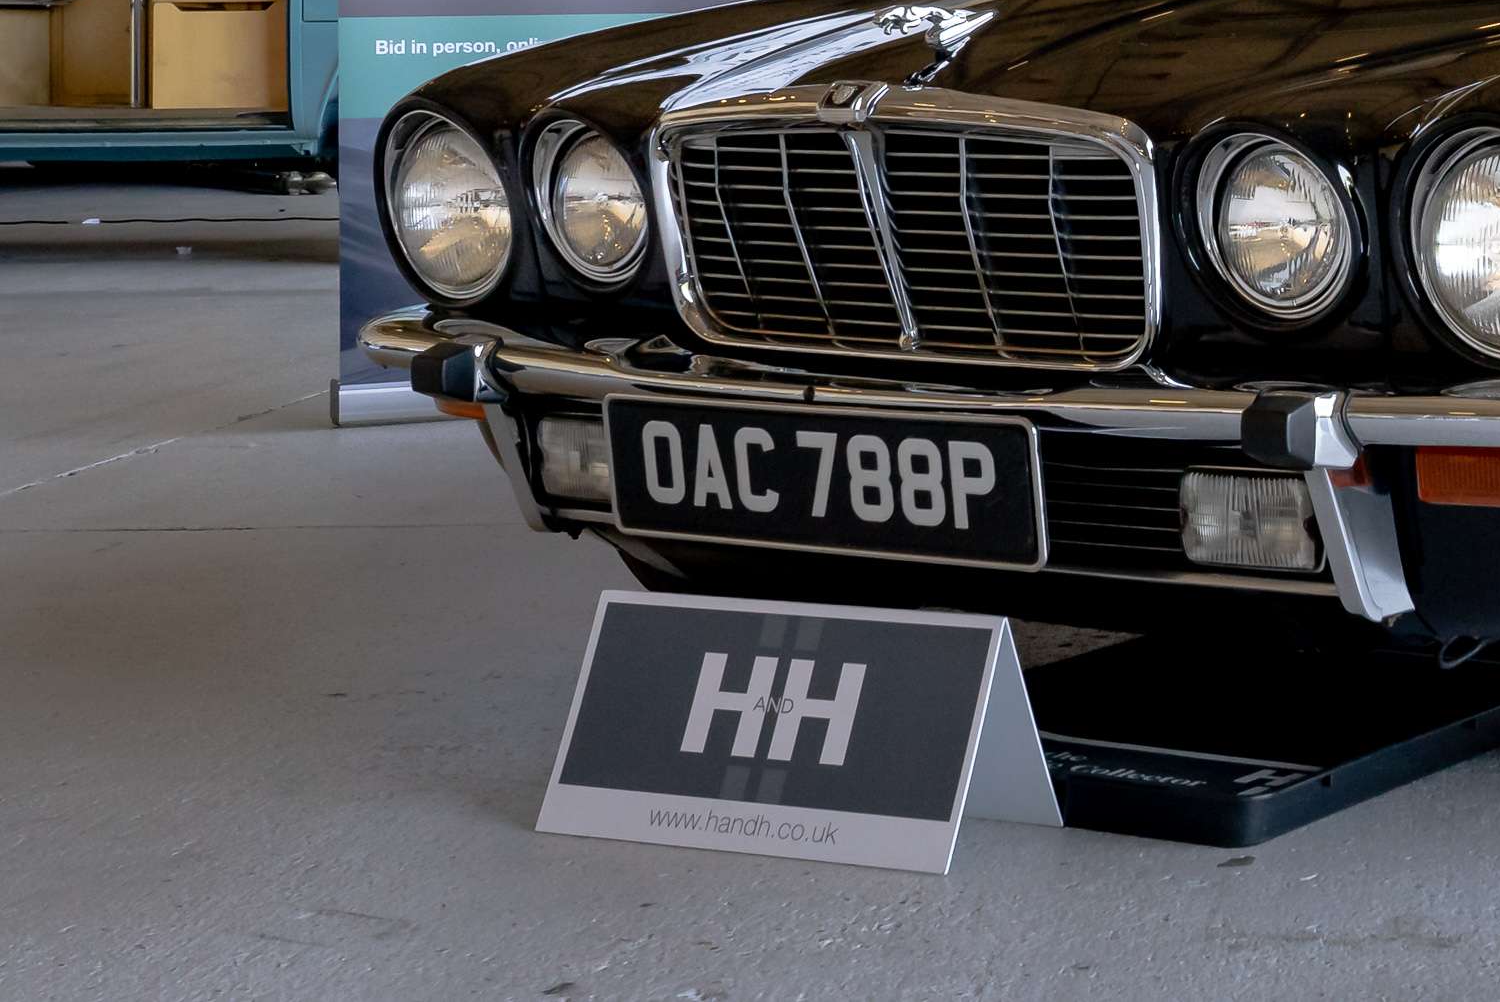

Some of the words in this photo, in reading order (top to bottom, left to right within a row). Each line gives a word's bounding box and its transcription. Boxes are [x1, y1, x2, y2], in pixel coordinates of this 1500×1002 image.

[376, 40, 405, 54] Bid
[412, 40, 426, 54] in
[643, 421, 779, 512] OAC
[796, 431, 995, 529] 788P
[752, 696, 794, 714] AND
[1070, 764, 1207, 788] Collector
[651, 810, 838, 844] www.handh.co.uk
